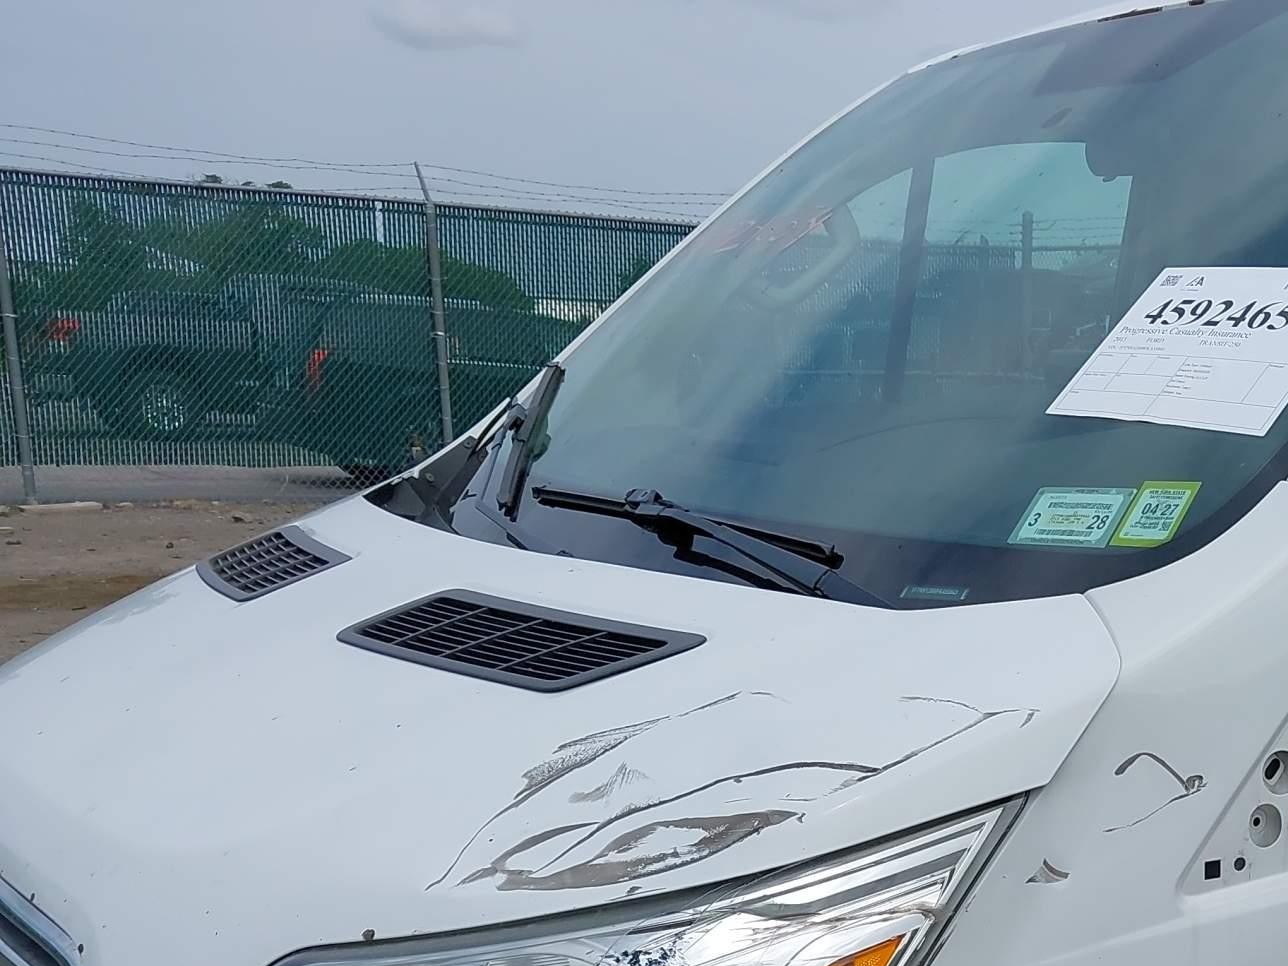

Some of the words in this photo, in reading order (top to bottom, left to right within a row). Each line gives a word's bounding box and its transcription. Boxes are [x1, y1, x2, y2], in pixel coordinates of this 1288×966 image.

[1120, 325, 1168, 336] Progressive
[1169, 327, 1204, 338] Casualty
[1207, 328, 1252, 339] Insurance
[1028, 512, 1042, 527] 3
[1086, 514, 1110, 530] 28
